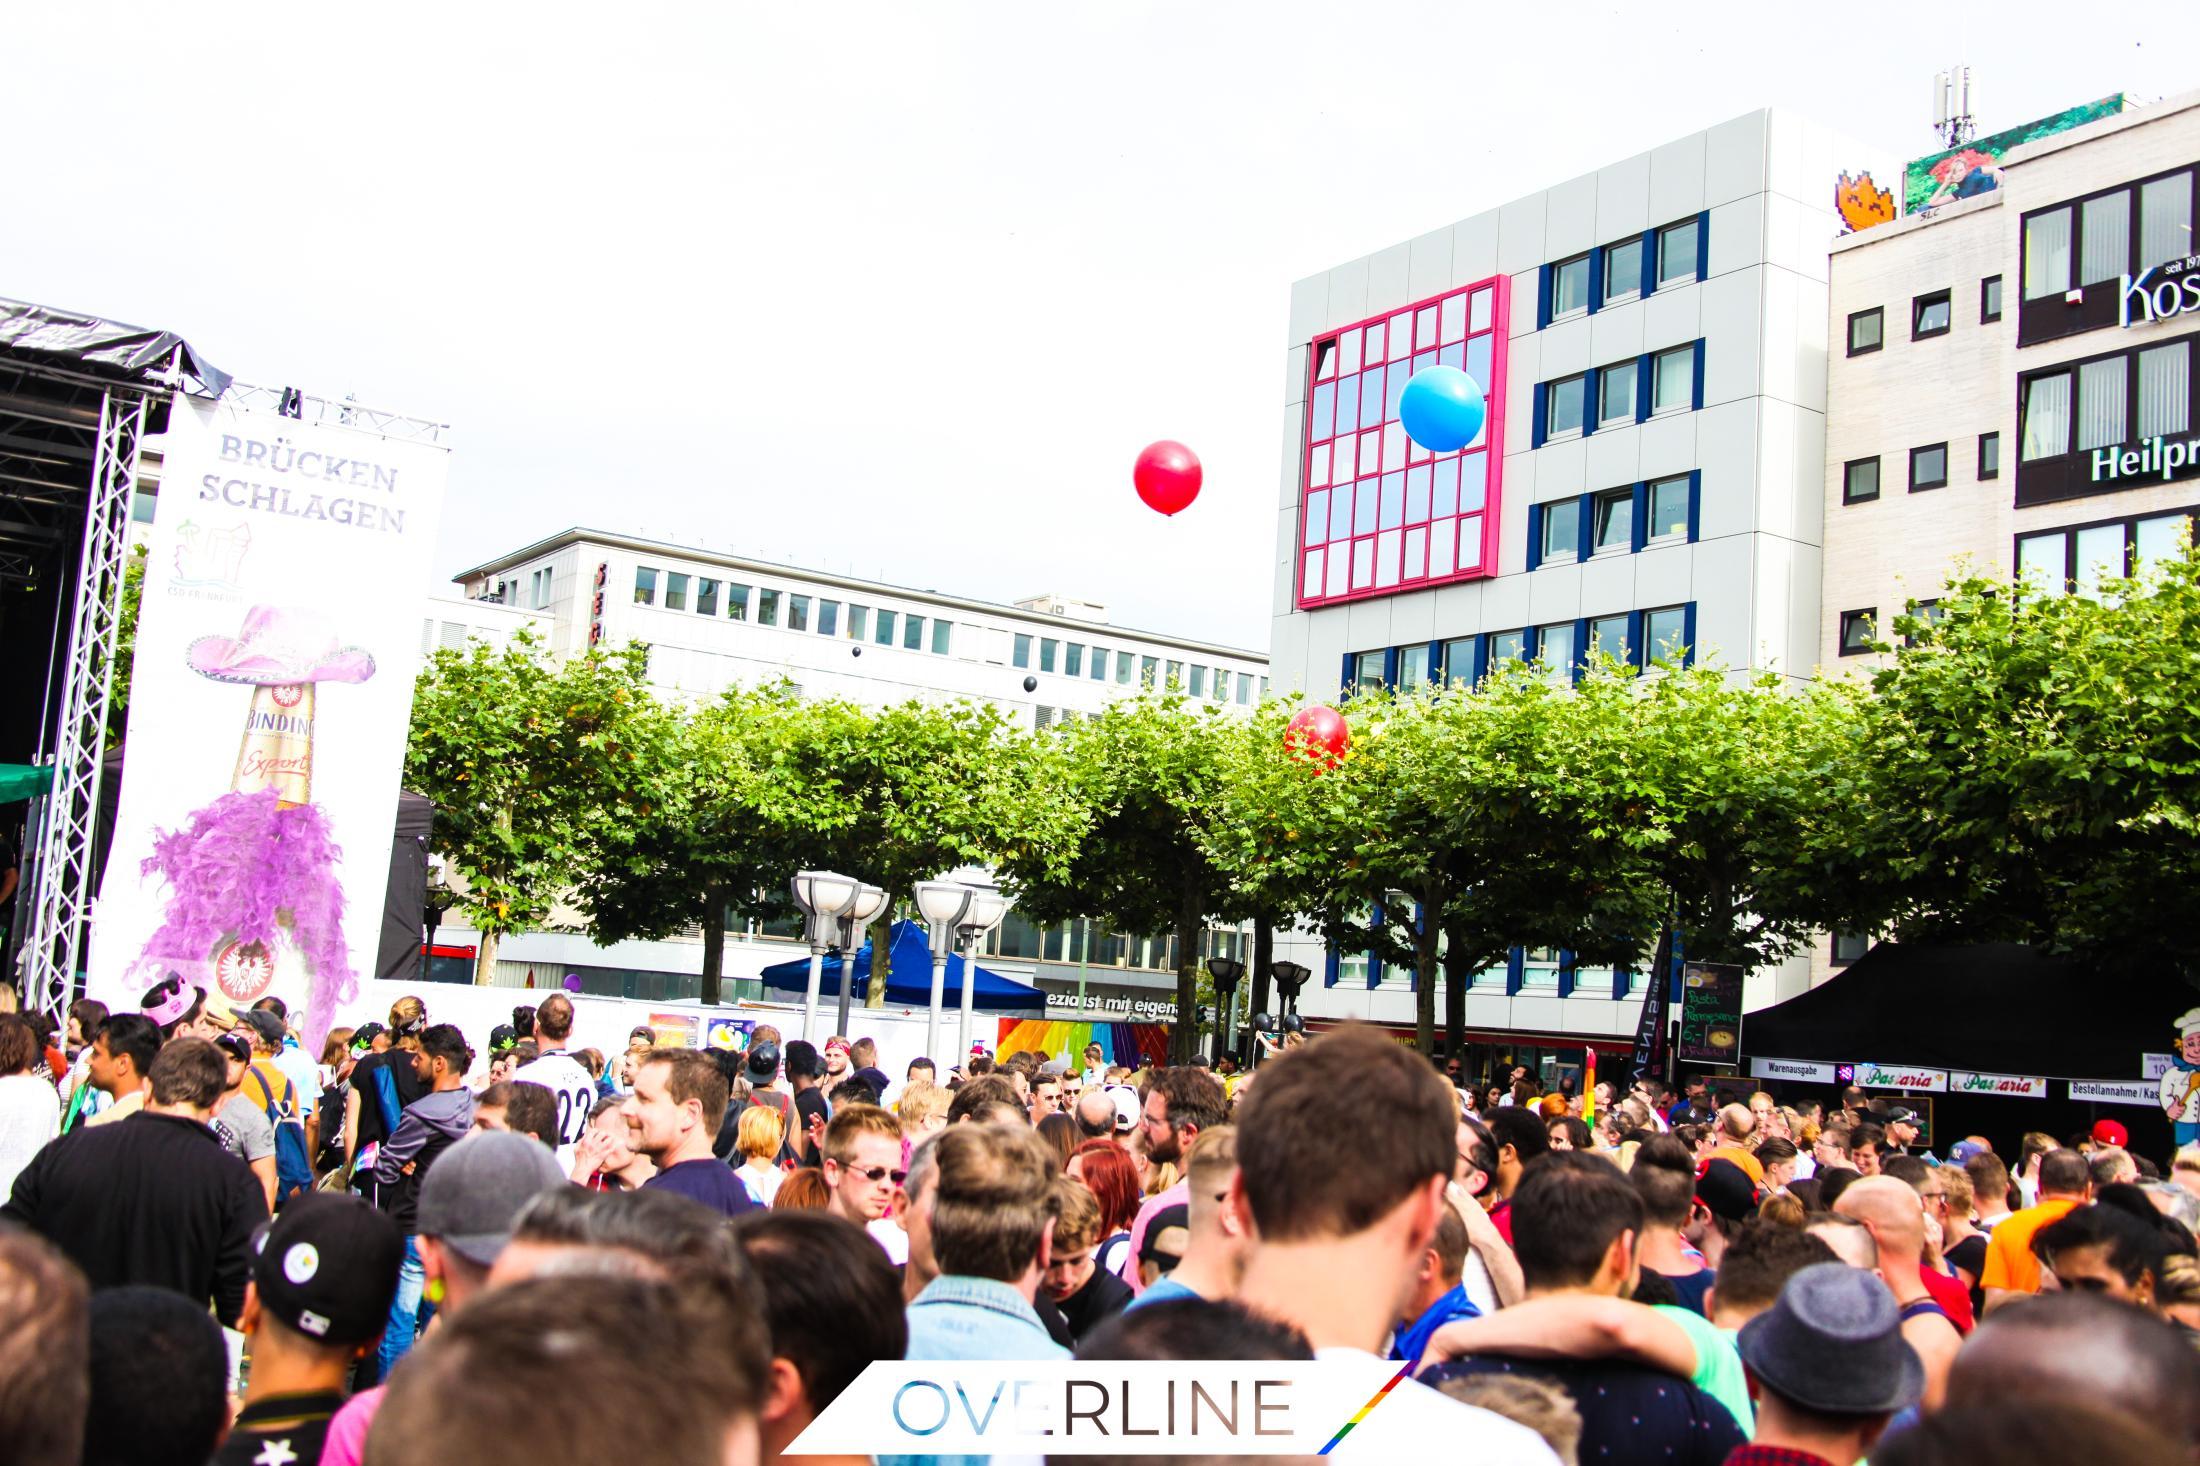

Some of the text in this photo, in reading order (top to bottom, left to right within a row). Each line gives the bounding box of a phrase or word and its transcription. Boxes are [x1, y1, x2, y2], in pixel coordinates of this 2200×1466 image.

[2165, 260, 2183, 275] seit
[219, 434, 398, 493] BRÜCKEN
[2092, 436, 2200, 480] Heilpr
[200, 474, 405, 534] SCHLAGEN
[243, 750, 311, 779] Export
[1047, 989, 1101, 1009] eziaist
[1105, 994, 1131, 1011] mit
[1768, 1061, 1818, 1076] Warenausgabe
[2073, 1082, 2137, 1098] Bestellannahme
[558, 1087, 591, 1146] 22
